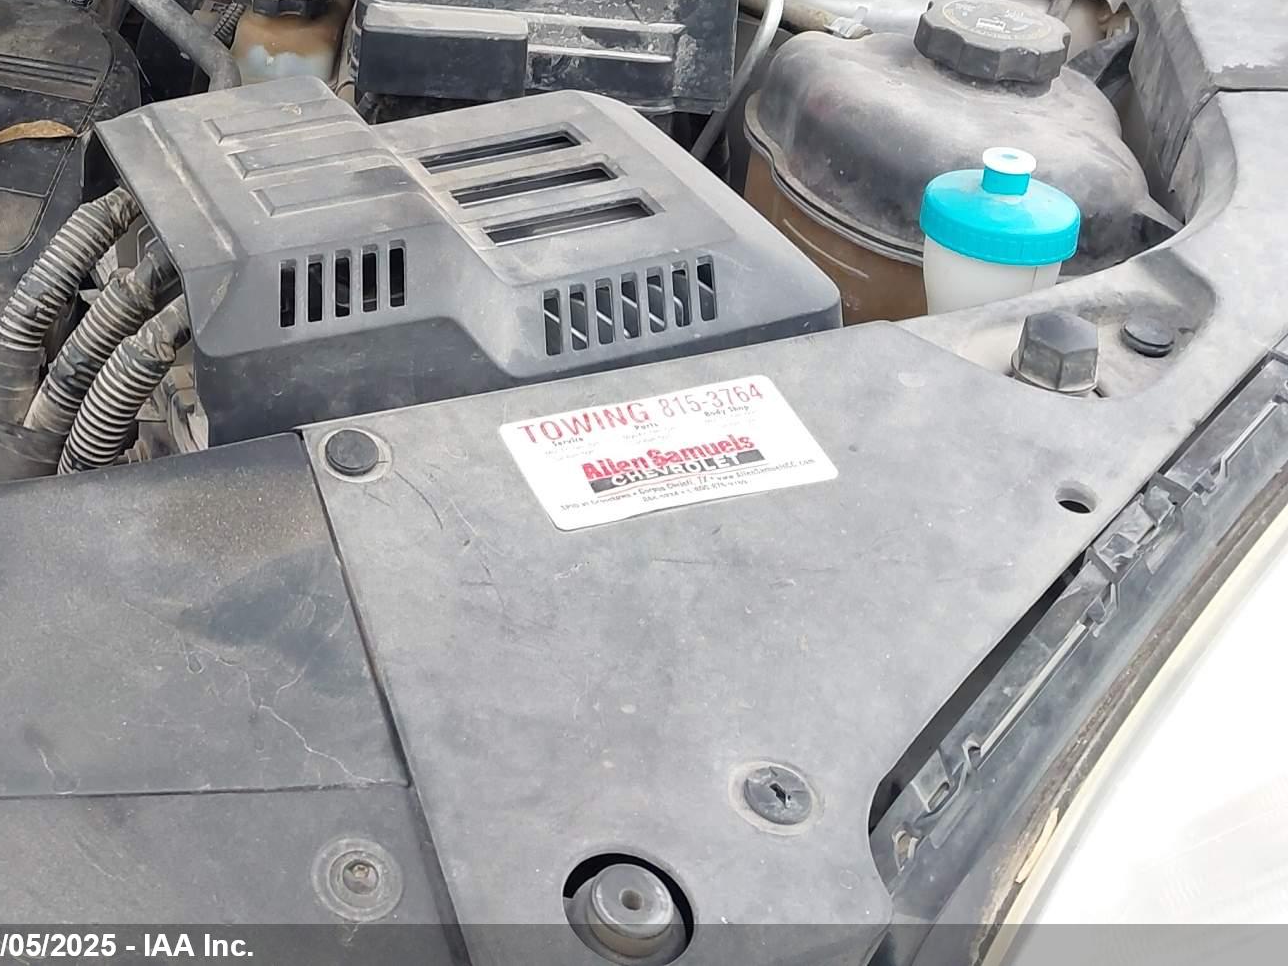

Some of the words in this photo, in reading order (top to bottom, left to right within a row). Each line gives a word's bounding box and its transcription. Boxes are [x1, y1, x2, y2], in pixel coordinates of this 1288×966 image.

[517, 401, 650, 444] TOWING
[658, 382, 763, 418] 815-3764
[581, 457, 650, 481] Allen
[646, 434, 755, 467] Samuels
[610, 454, 741, 487] CHEVROLET
